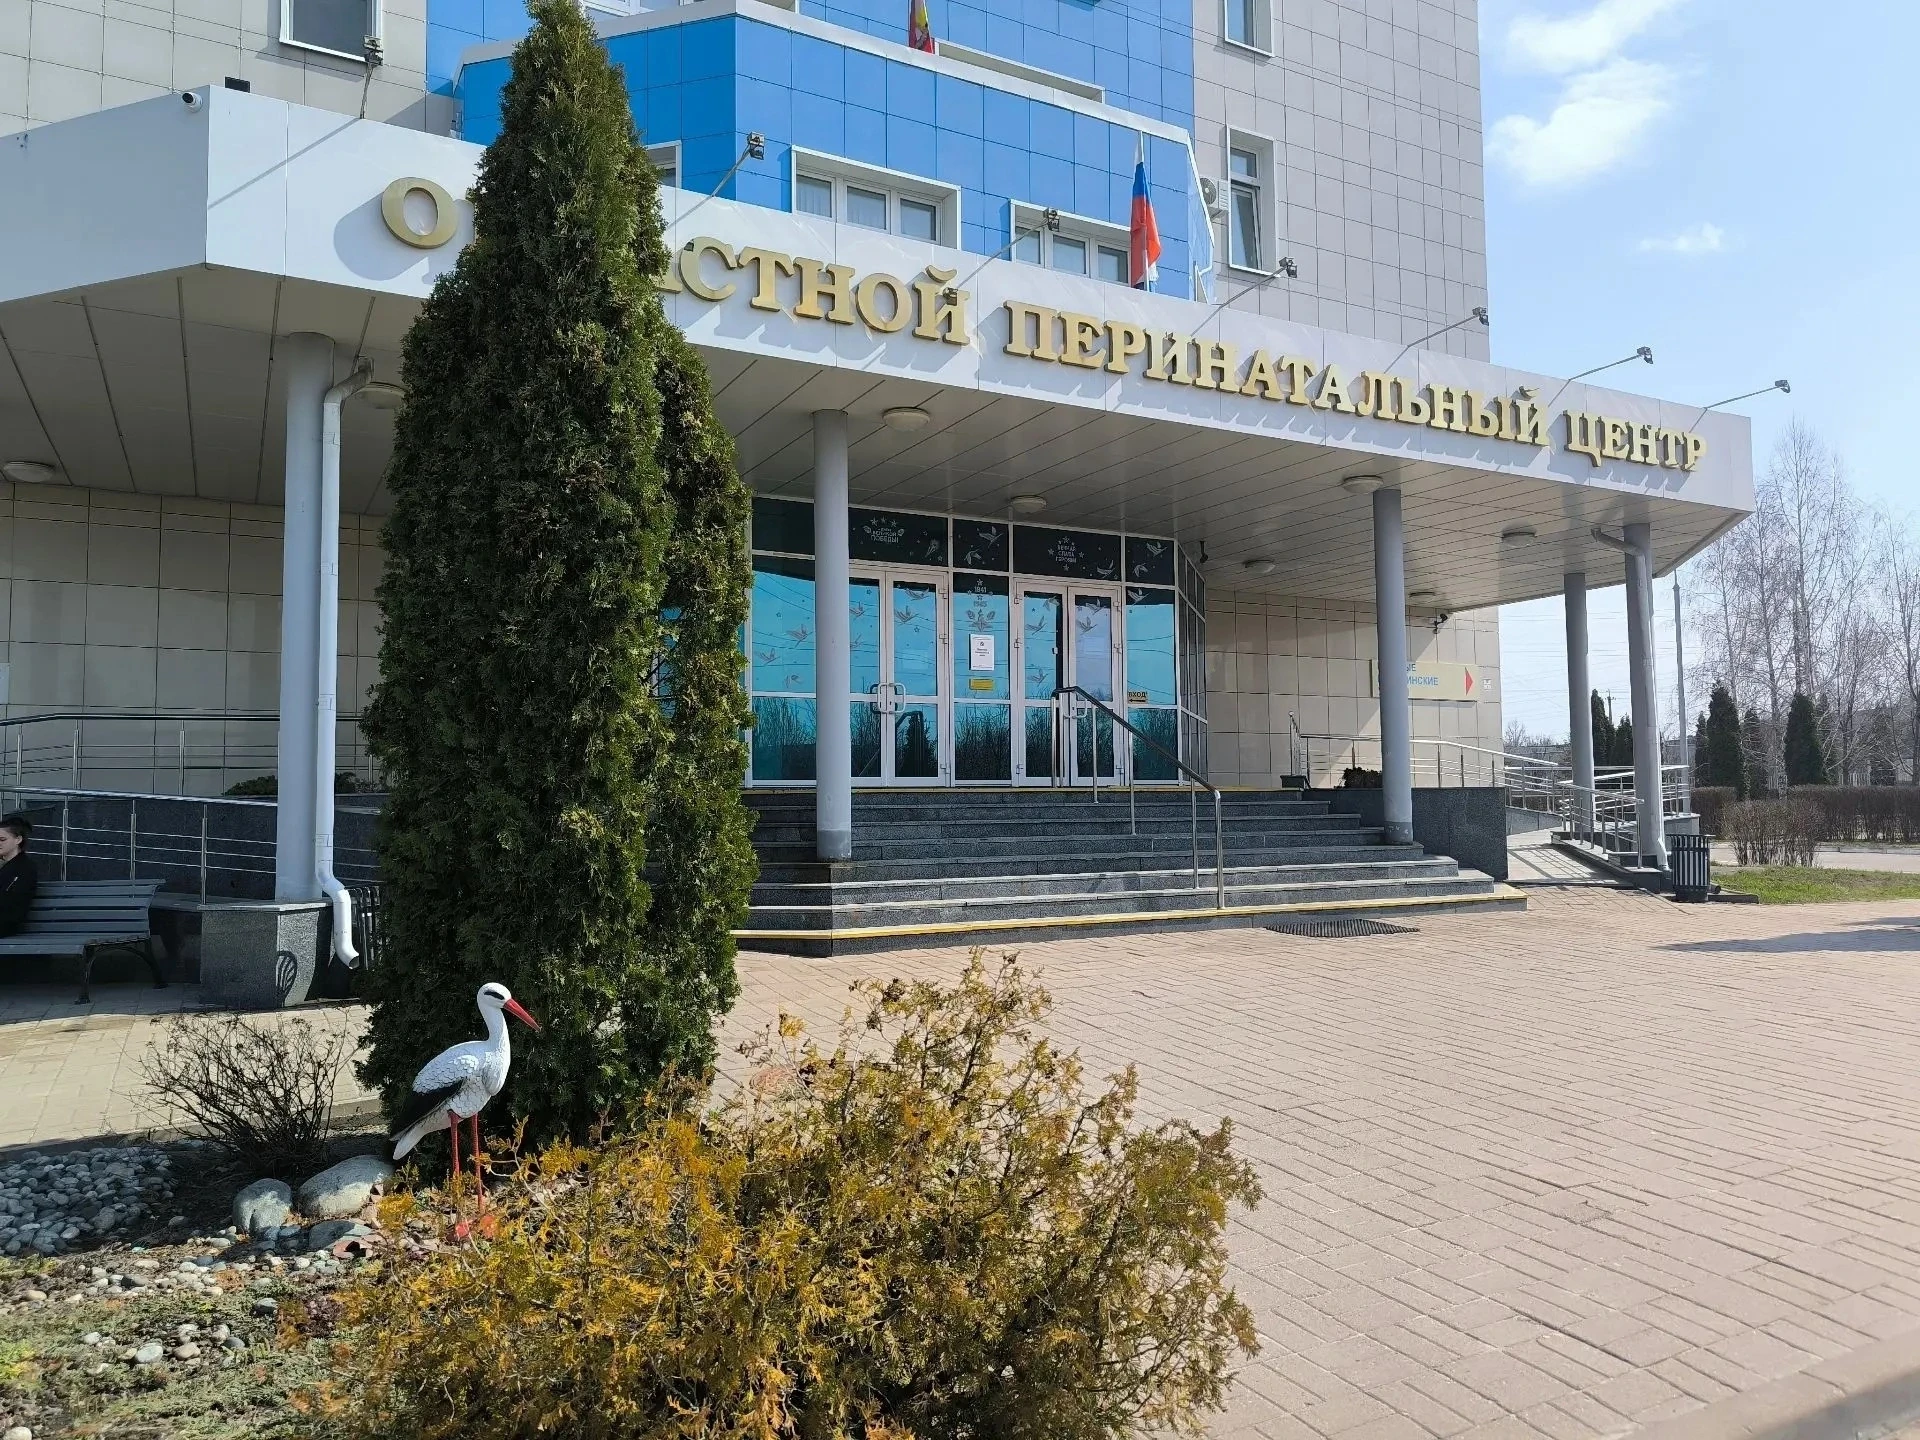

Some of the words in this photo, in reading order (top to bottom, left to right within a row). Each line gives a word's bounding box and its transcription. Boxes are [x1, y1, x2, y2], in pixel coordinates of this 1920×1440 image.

[382, 176, 971, 346] ОСТНОЙ
[1003, 300, 1551, 447] ПЕРИНАТАЛЬНЫЙ
[1563, 409, 1708, 472] ЦЕНТР
[1406, 676, 1439, 686] ИНСКИЕ
